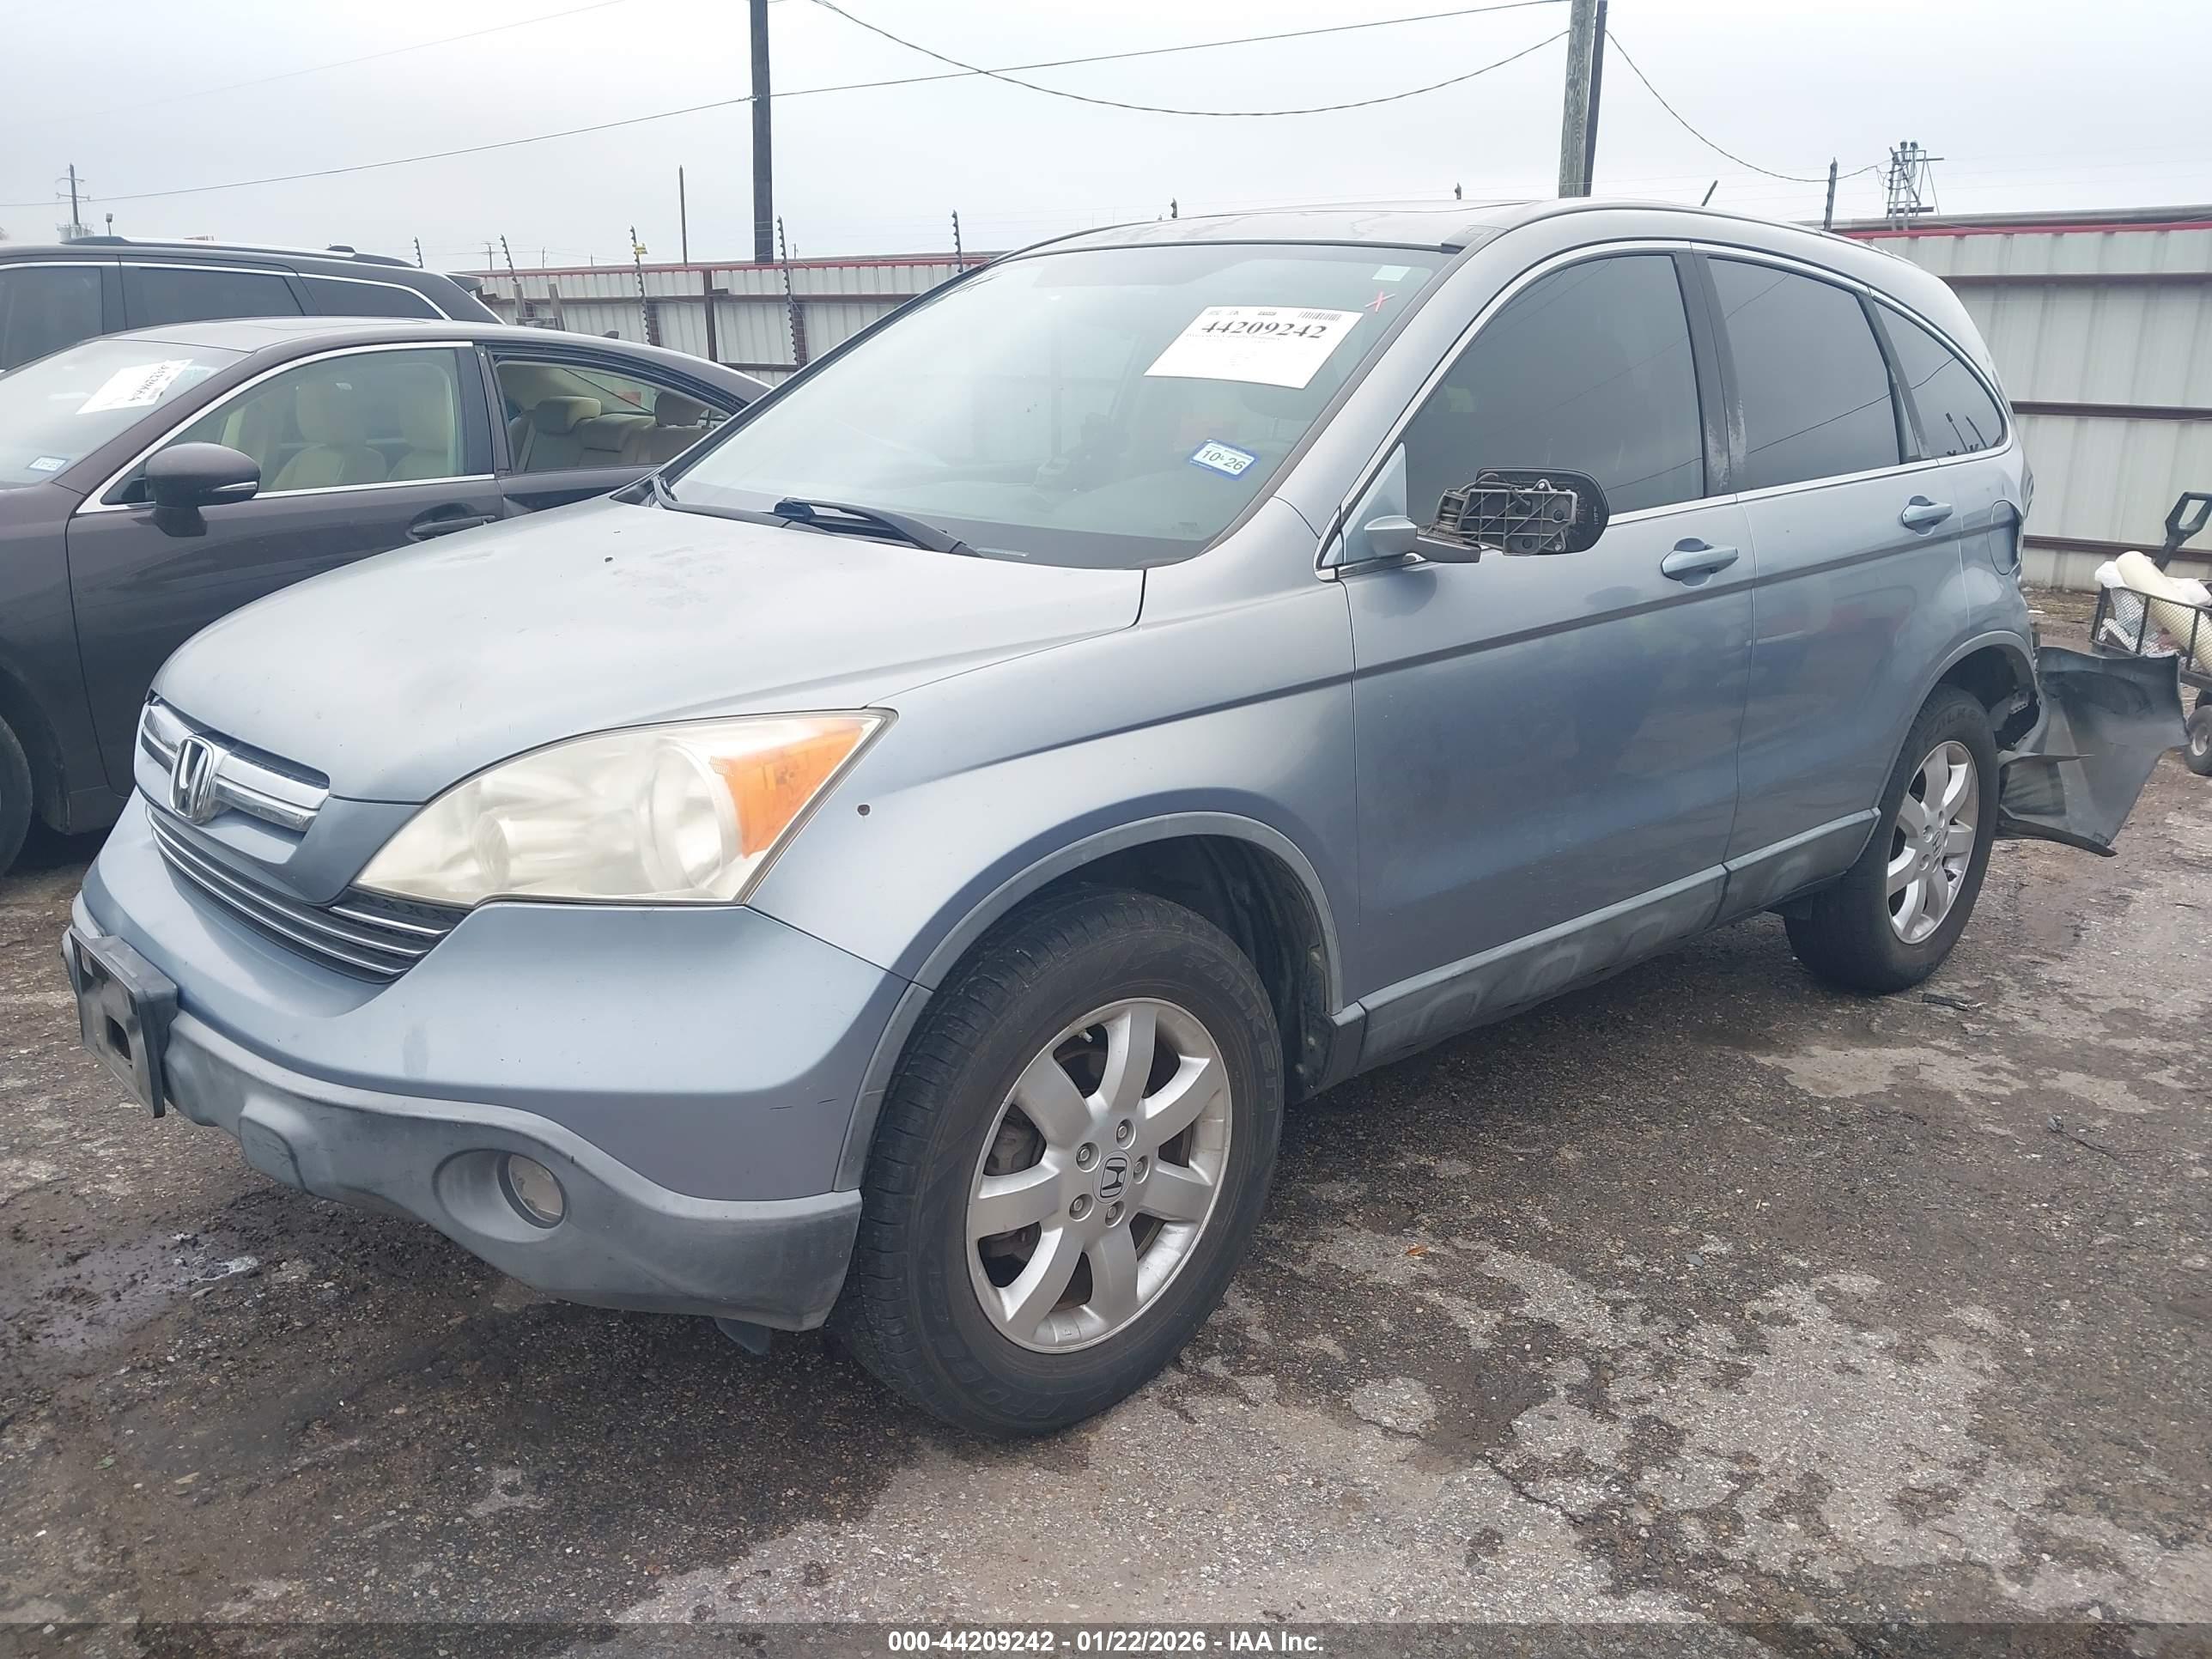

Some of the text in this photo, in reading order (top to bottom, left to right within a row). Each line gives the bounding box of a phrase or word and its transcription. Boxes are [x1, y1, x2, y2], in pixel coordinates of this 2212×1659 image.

[1201, 320, 1328, 338] 44209242
[1201, 449, 1221, 461] 10
[1223, 457, 1246, 470] 26
